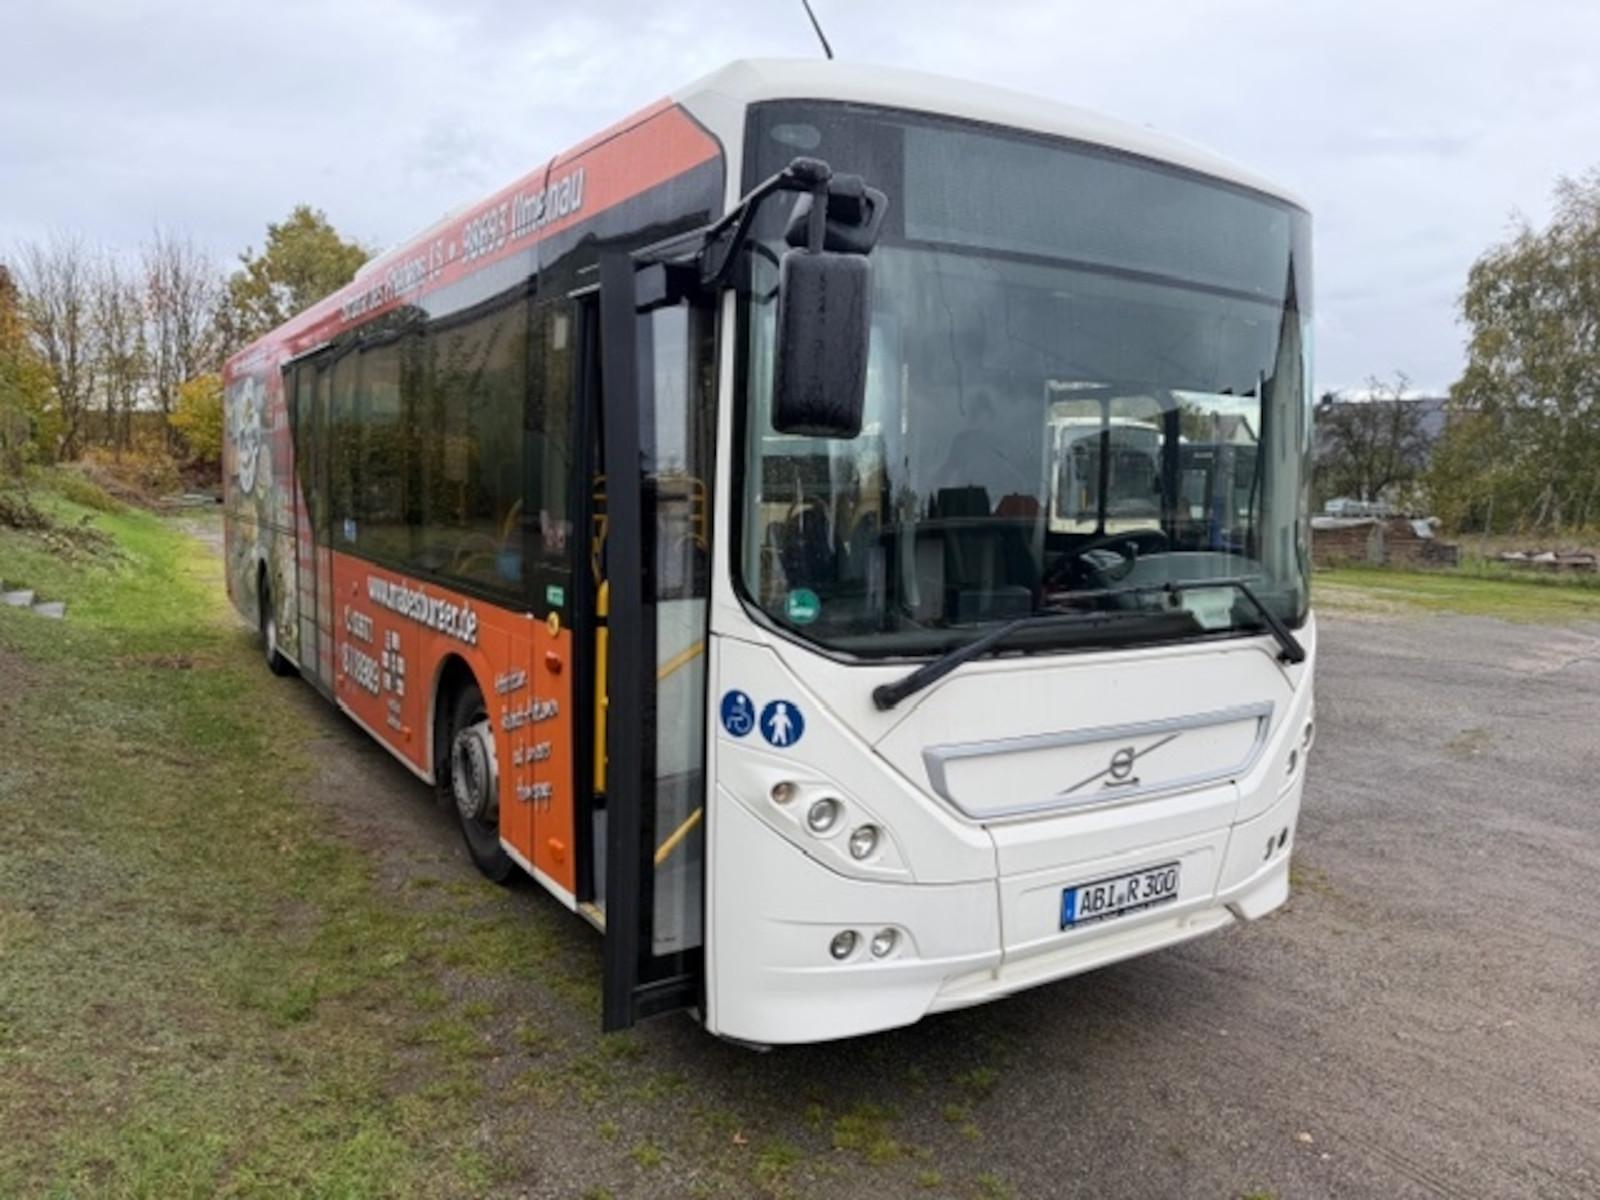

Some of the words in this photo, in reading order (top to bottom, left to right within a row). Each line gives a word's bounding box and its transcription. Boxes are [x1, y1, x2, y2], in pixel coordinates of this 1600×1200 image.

[511, 167, 585, 239] Ilmenau
[1079, 885, 1115, 915] ABI
[1127, 877, 1140, 903] R
[1142, 868, 1176, 898] 300
